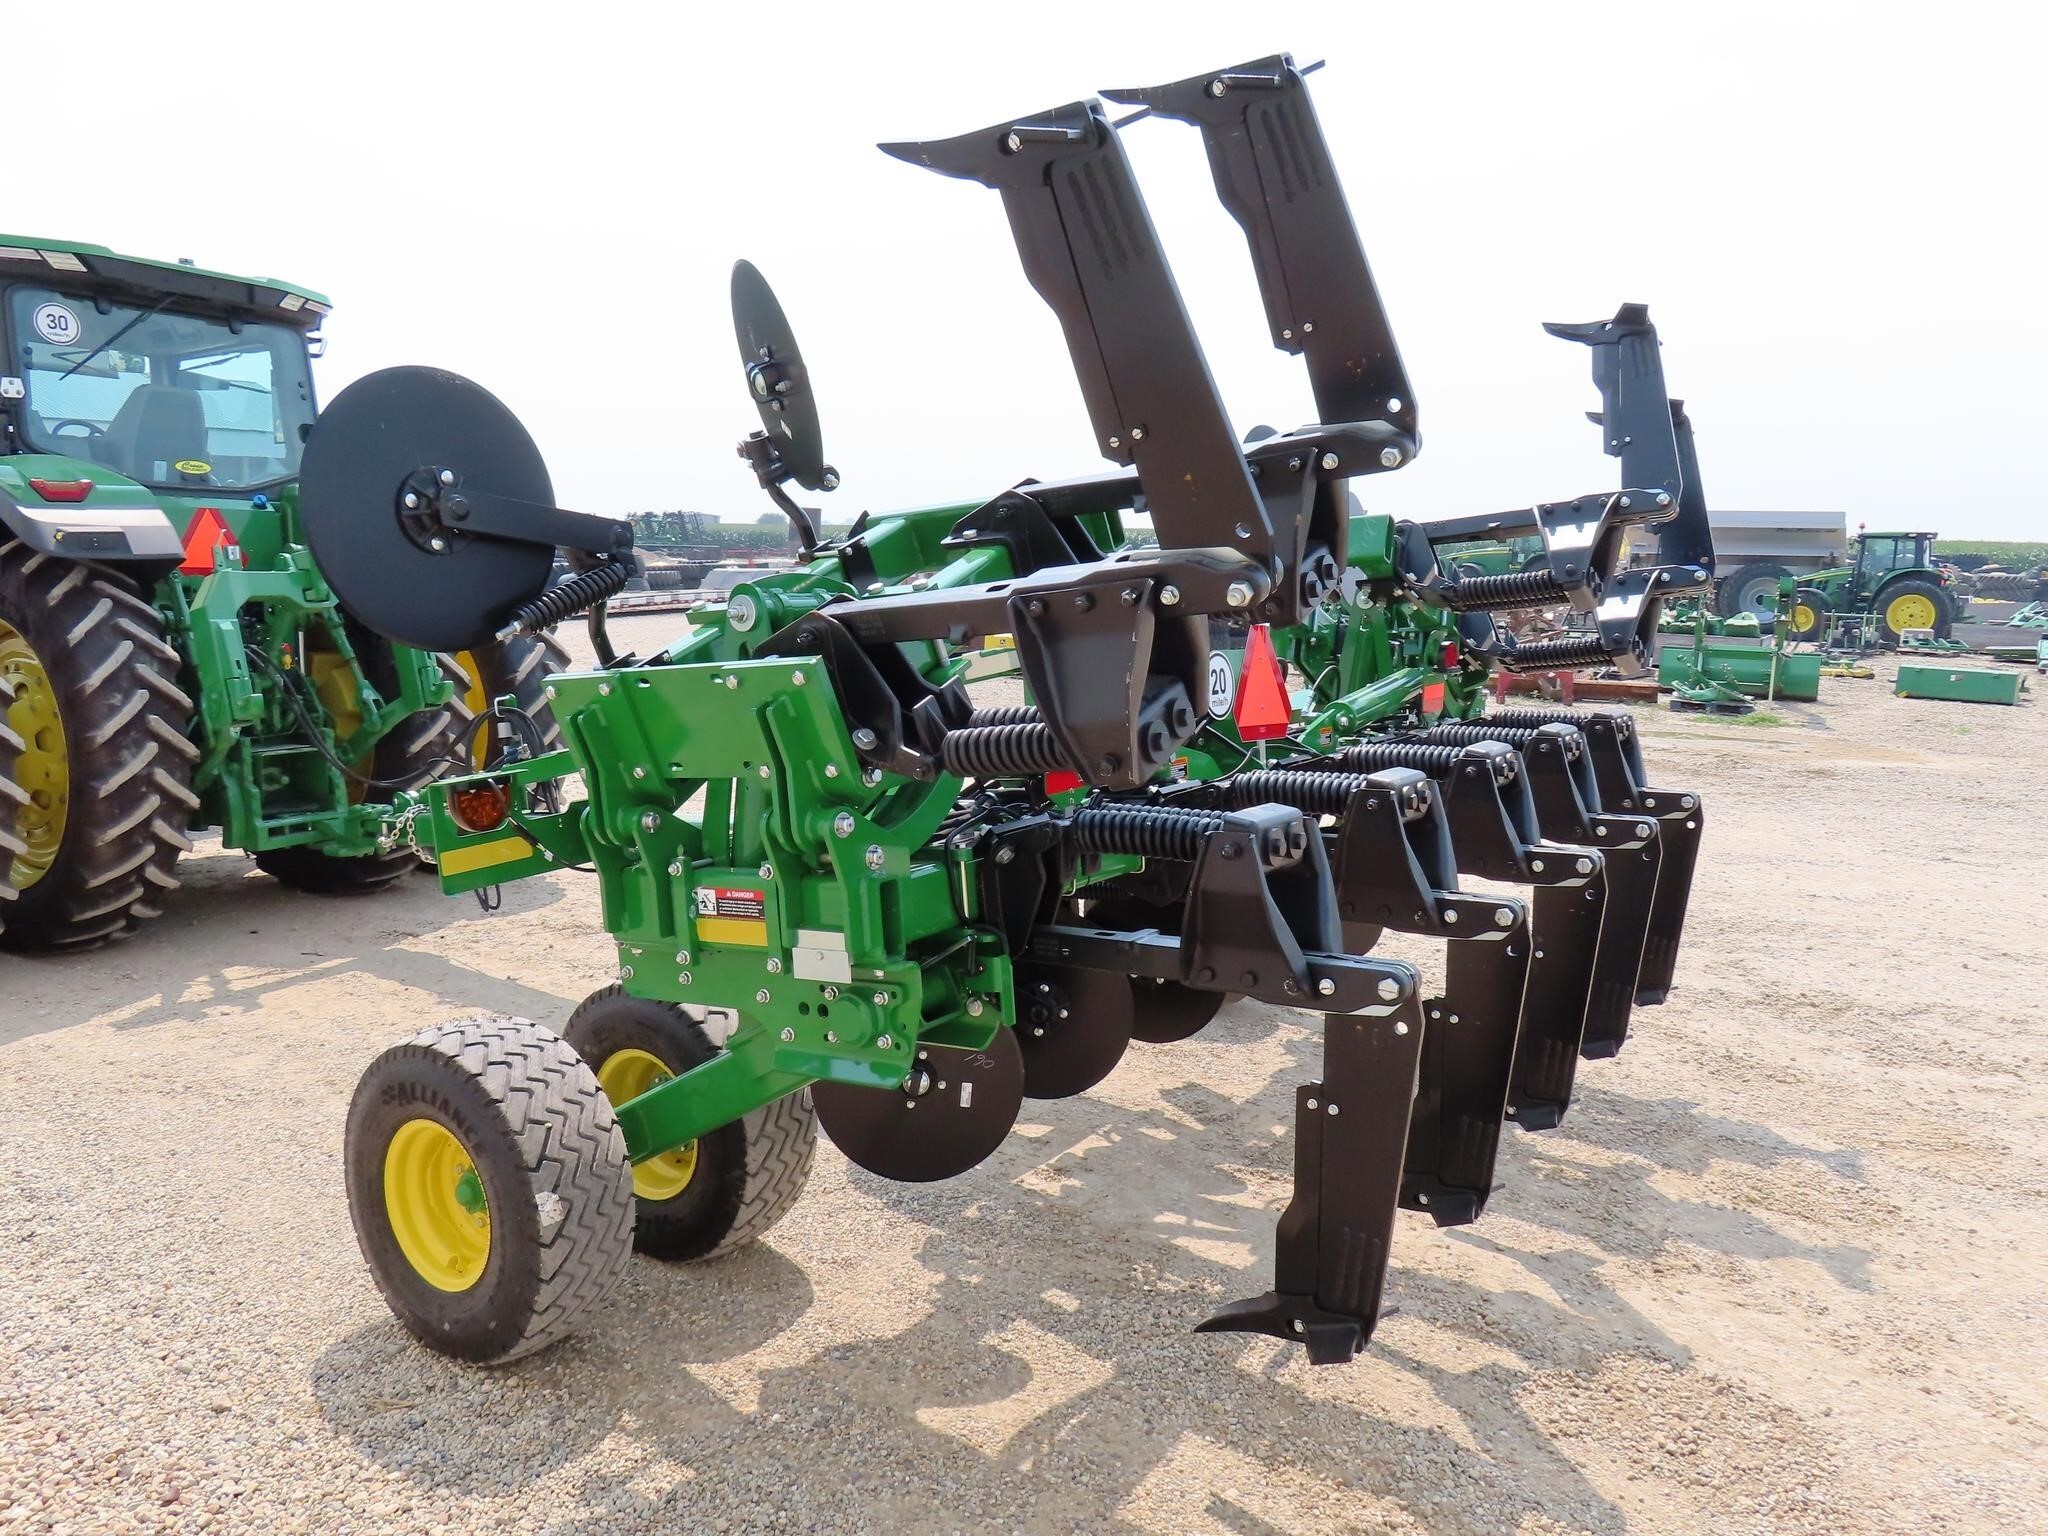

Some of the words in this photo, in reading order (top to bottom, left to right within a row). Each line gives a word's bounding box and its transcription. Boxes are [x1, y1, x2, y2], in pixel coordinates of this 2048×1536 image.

[46, 313, 69, 331] 30
[1211, 668, 1227, 696] 20
[1211, 696, 1229, 708] mile/h
[731, 891, 755, 899] DANGER
